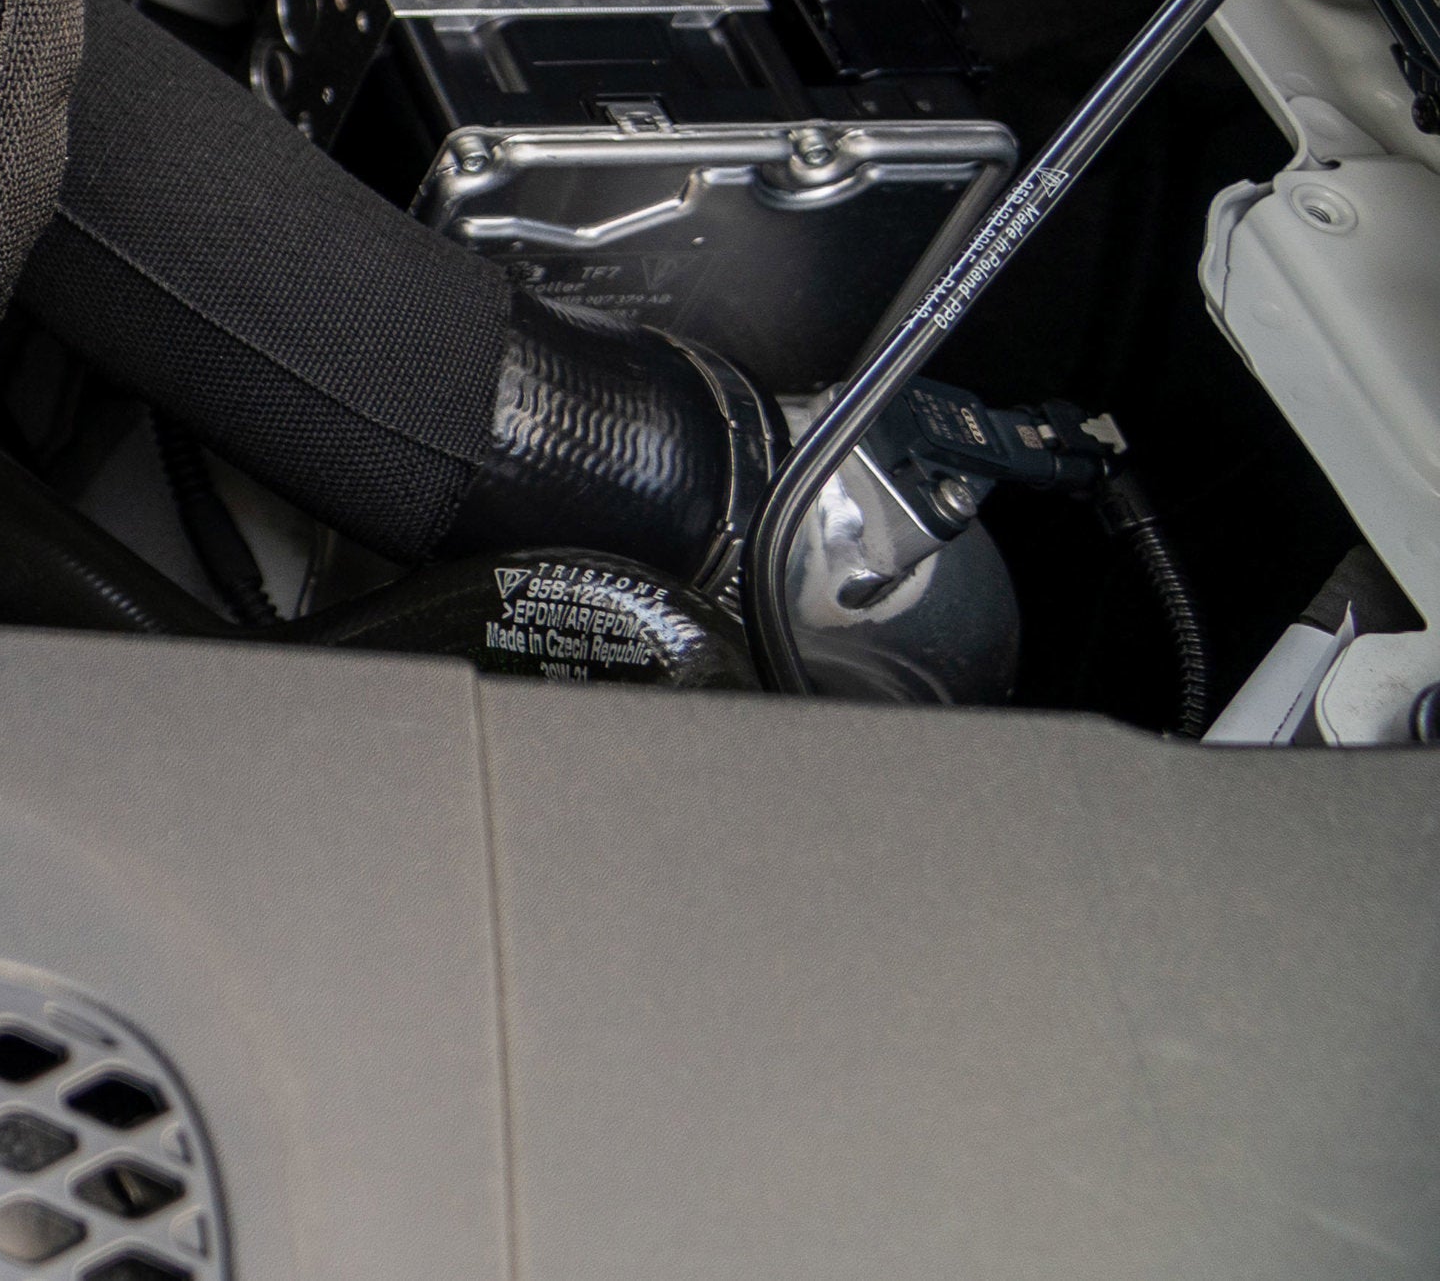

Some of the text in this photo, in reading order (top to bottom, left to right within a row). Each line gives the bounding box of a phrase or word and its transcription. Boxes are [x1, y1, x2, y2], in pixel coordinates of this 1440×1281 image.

[933, 202, 1041, 330] Made in Poland PPO
[536, 561, 670, 602] TRISTONE
[501, 601, 657, 641] >EPDM/AR/EPDM<
[485, 620, 651, 669] Made in Czech Republic
